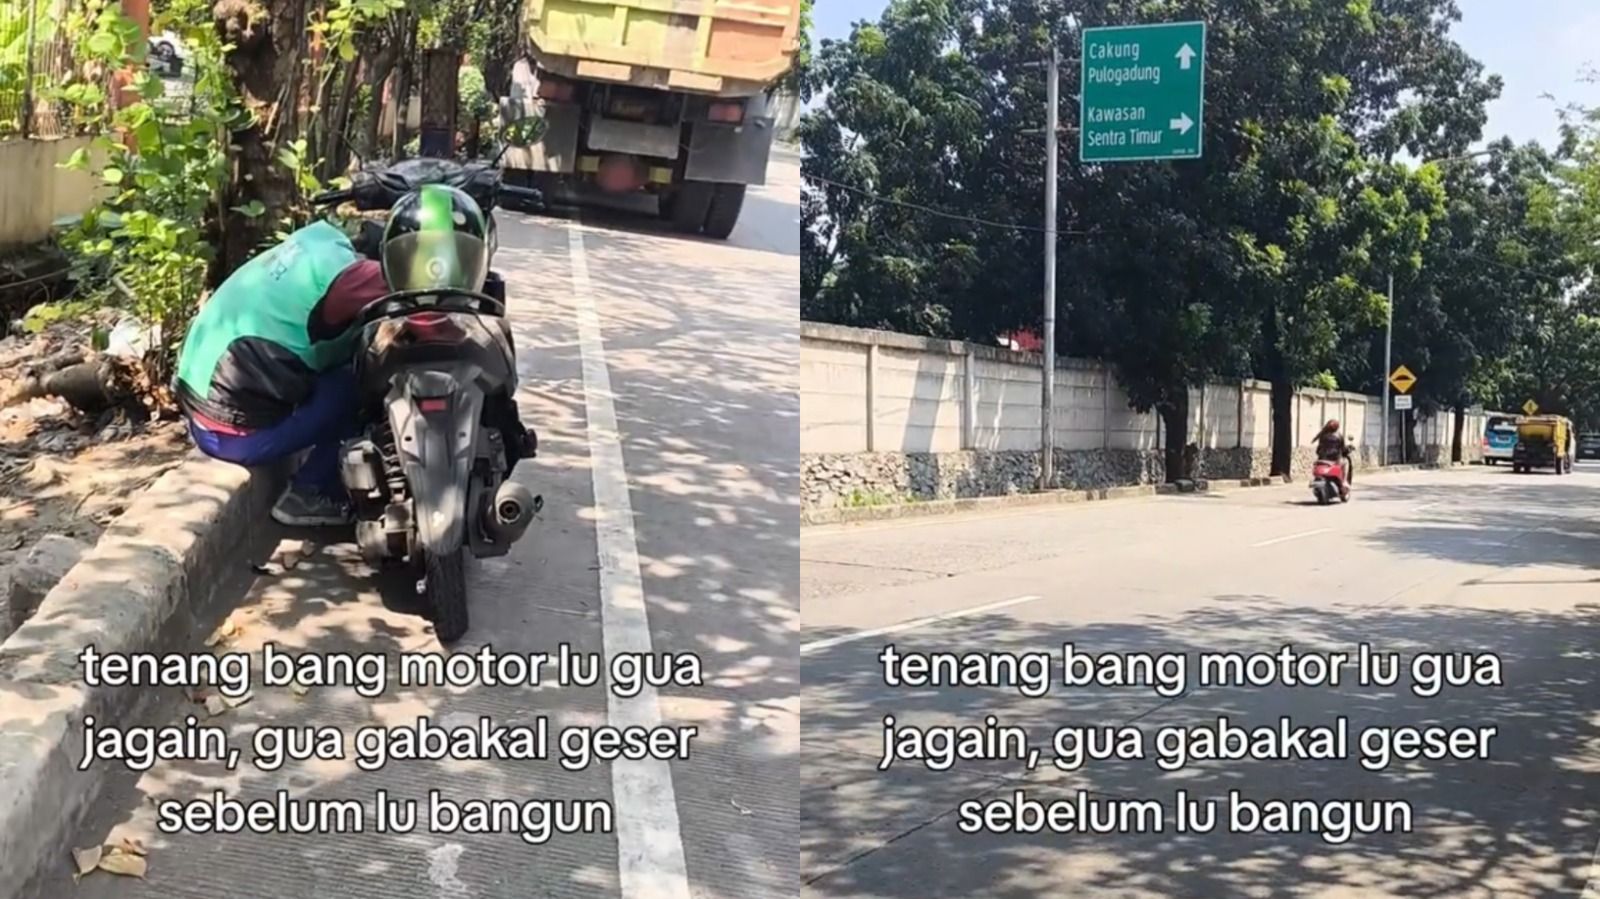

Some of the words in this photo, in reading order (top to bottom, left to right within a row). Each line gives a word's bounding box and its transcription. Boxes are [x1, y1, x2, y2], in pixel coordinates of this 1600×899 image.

[1089, 42, 1140, 61] Cakung
[1088, 64, 1160, 86] Pulogadung
[1088, 106, 1145, 122] Kawasan
[1088, 130, 1126, 146] Sentra
[1130, 128, 1163, 145] Timur
